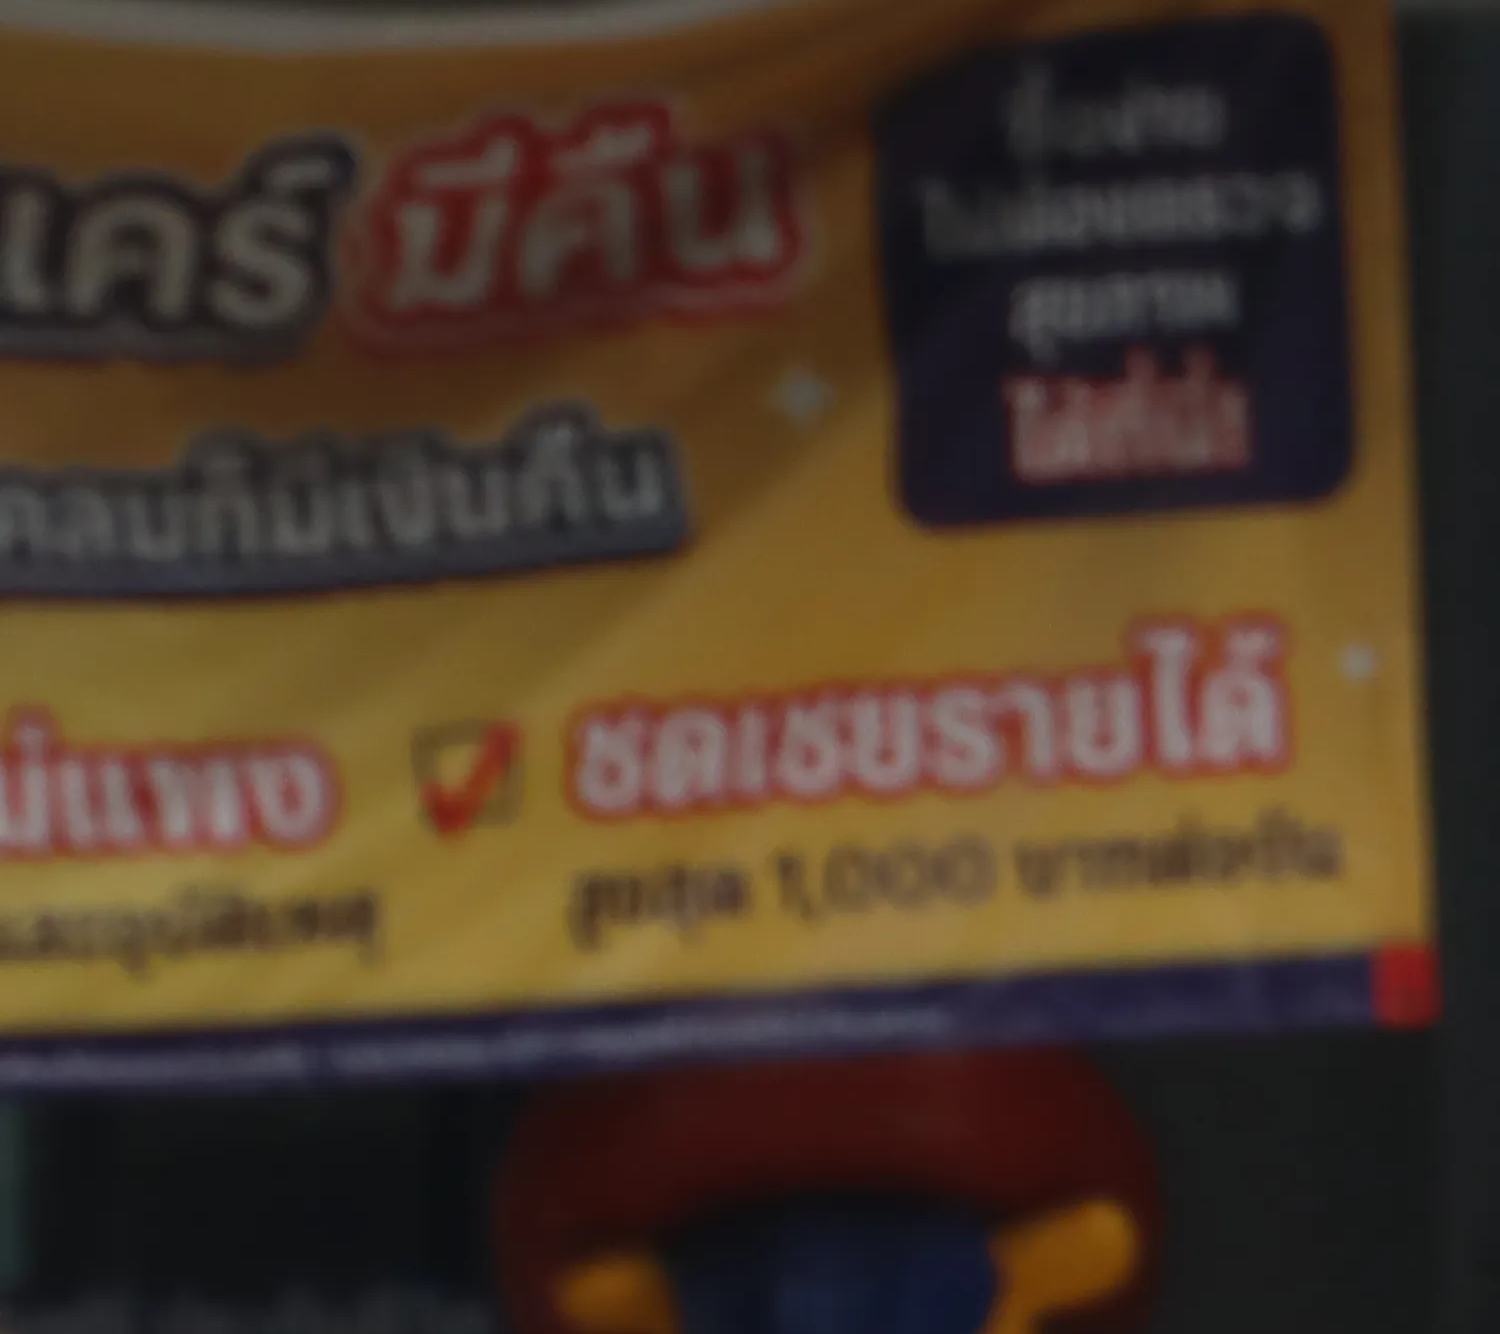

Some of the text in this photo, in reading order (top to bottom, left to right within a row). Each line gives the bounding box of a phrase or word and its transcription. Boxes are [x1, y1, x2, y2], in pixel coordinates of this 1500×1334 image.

[572, 622, 1286, 814] ชดเชยรายได้
[769, 830, 997, 927] 1,000
